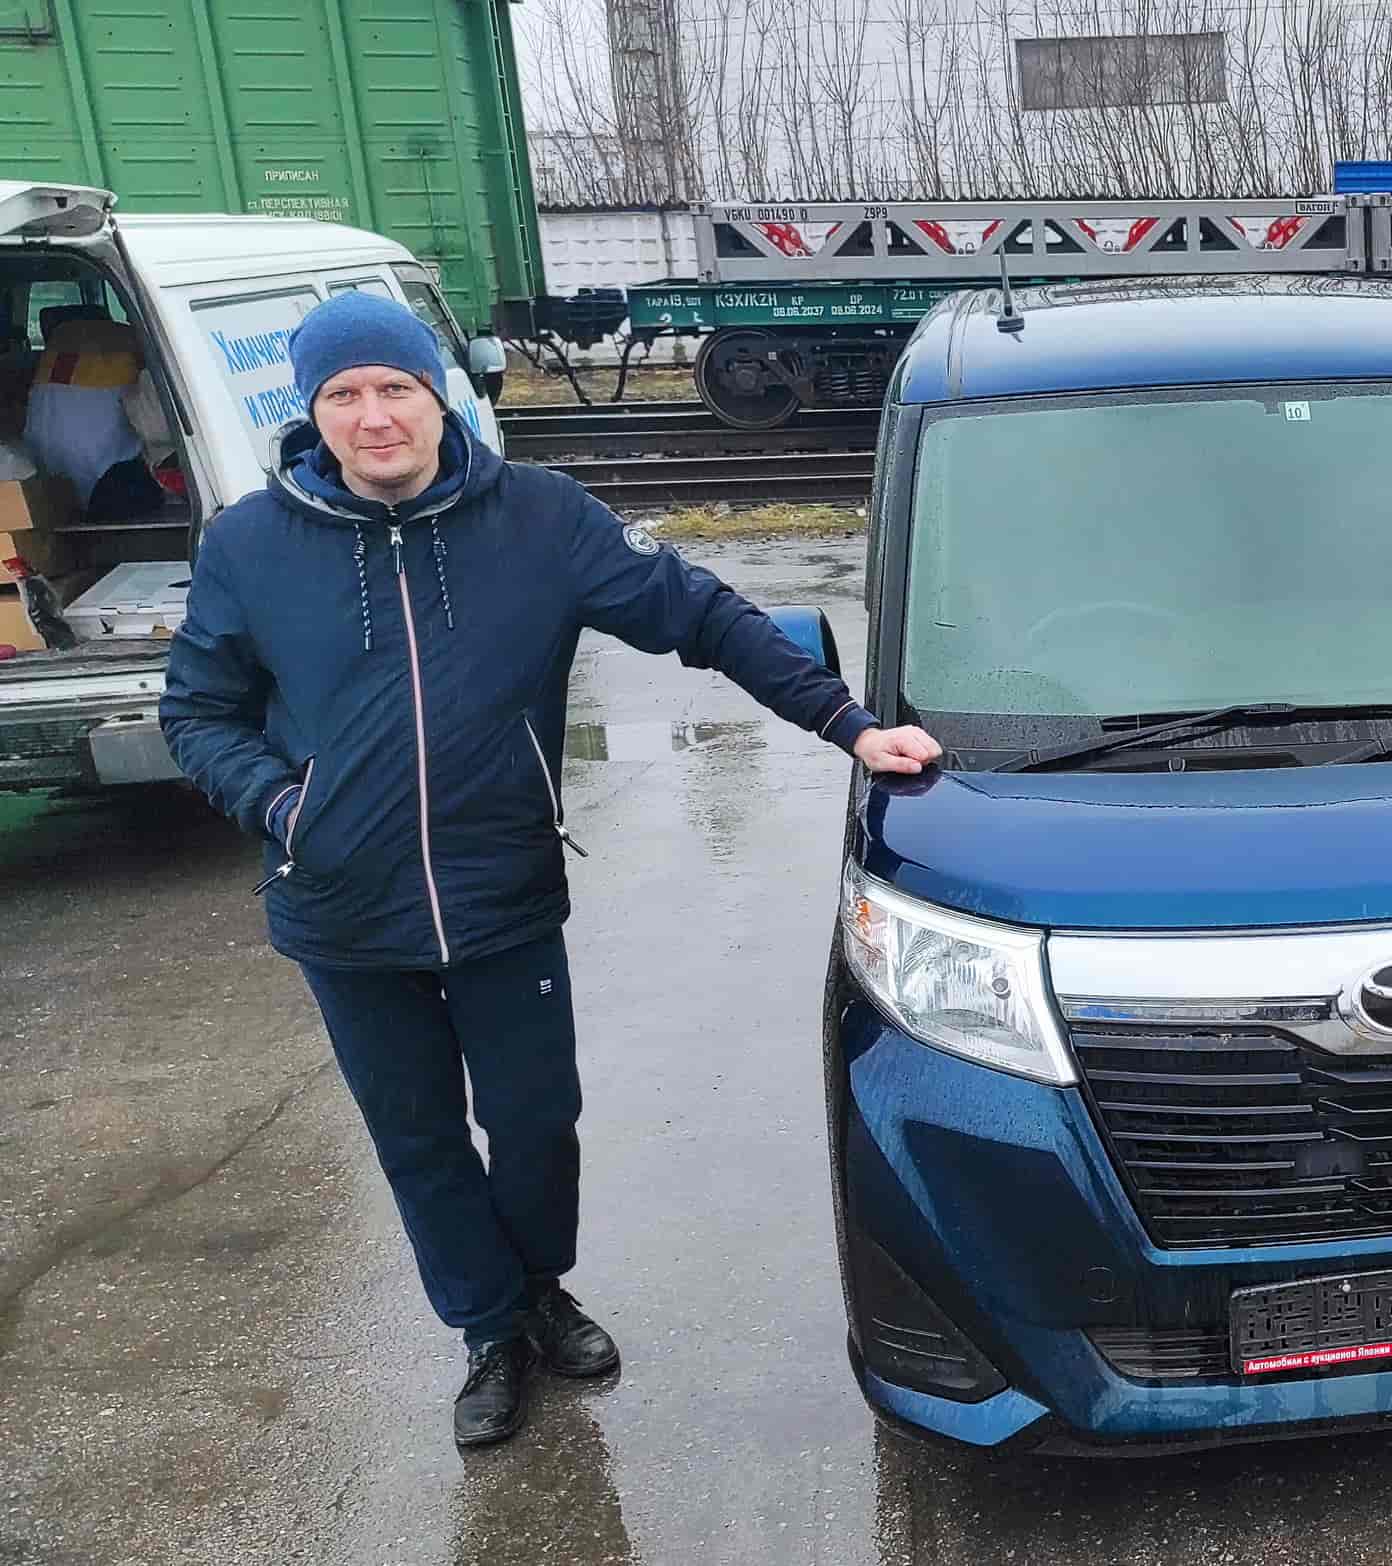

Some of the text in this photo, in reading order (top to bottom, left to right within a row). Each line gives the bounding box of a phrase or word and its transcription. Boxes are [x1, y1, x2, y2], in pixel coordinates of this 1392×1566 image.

[264, 170, 319, 182] ПРИПИСАН
[758, 208, 795, 221] 001490
[1287, 407, 1303, 419] 10
[1247, 1358, 1302, 1372] Автомобили
[1311, 1350, 1357, 1366] аукционов
[1357, 1346, 1391, 1358] Японии
